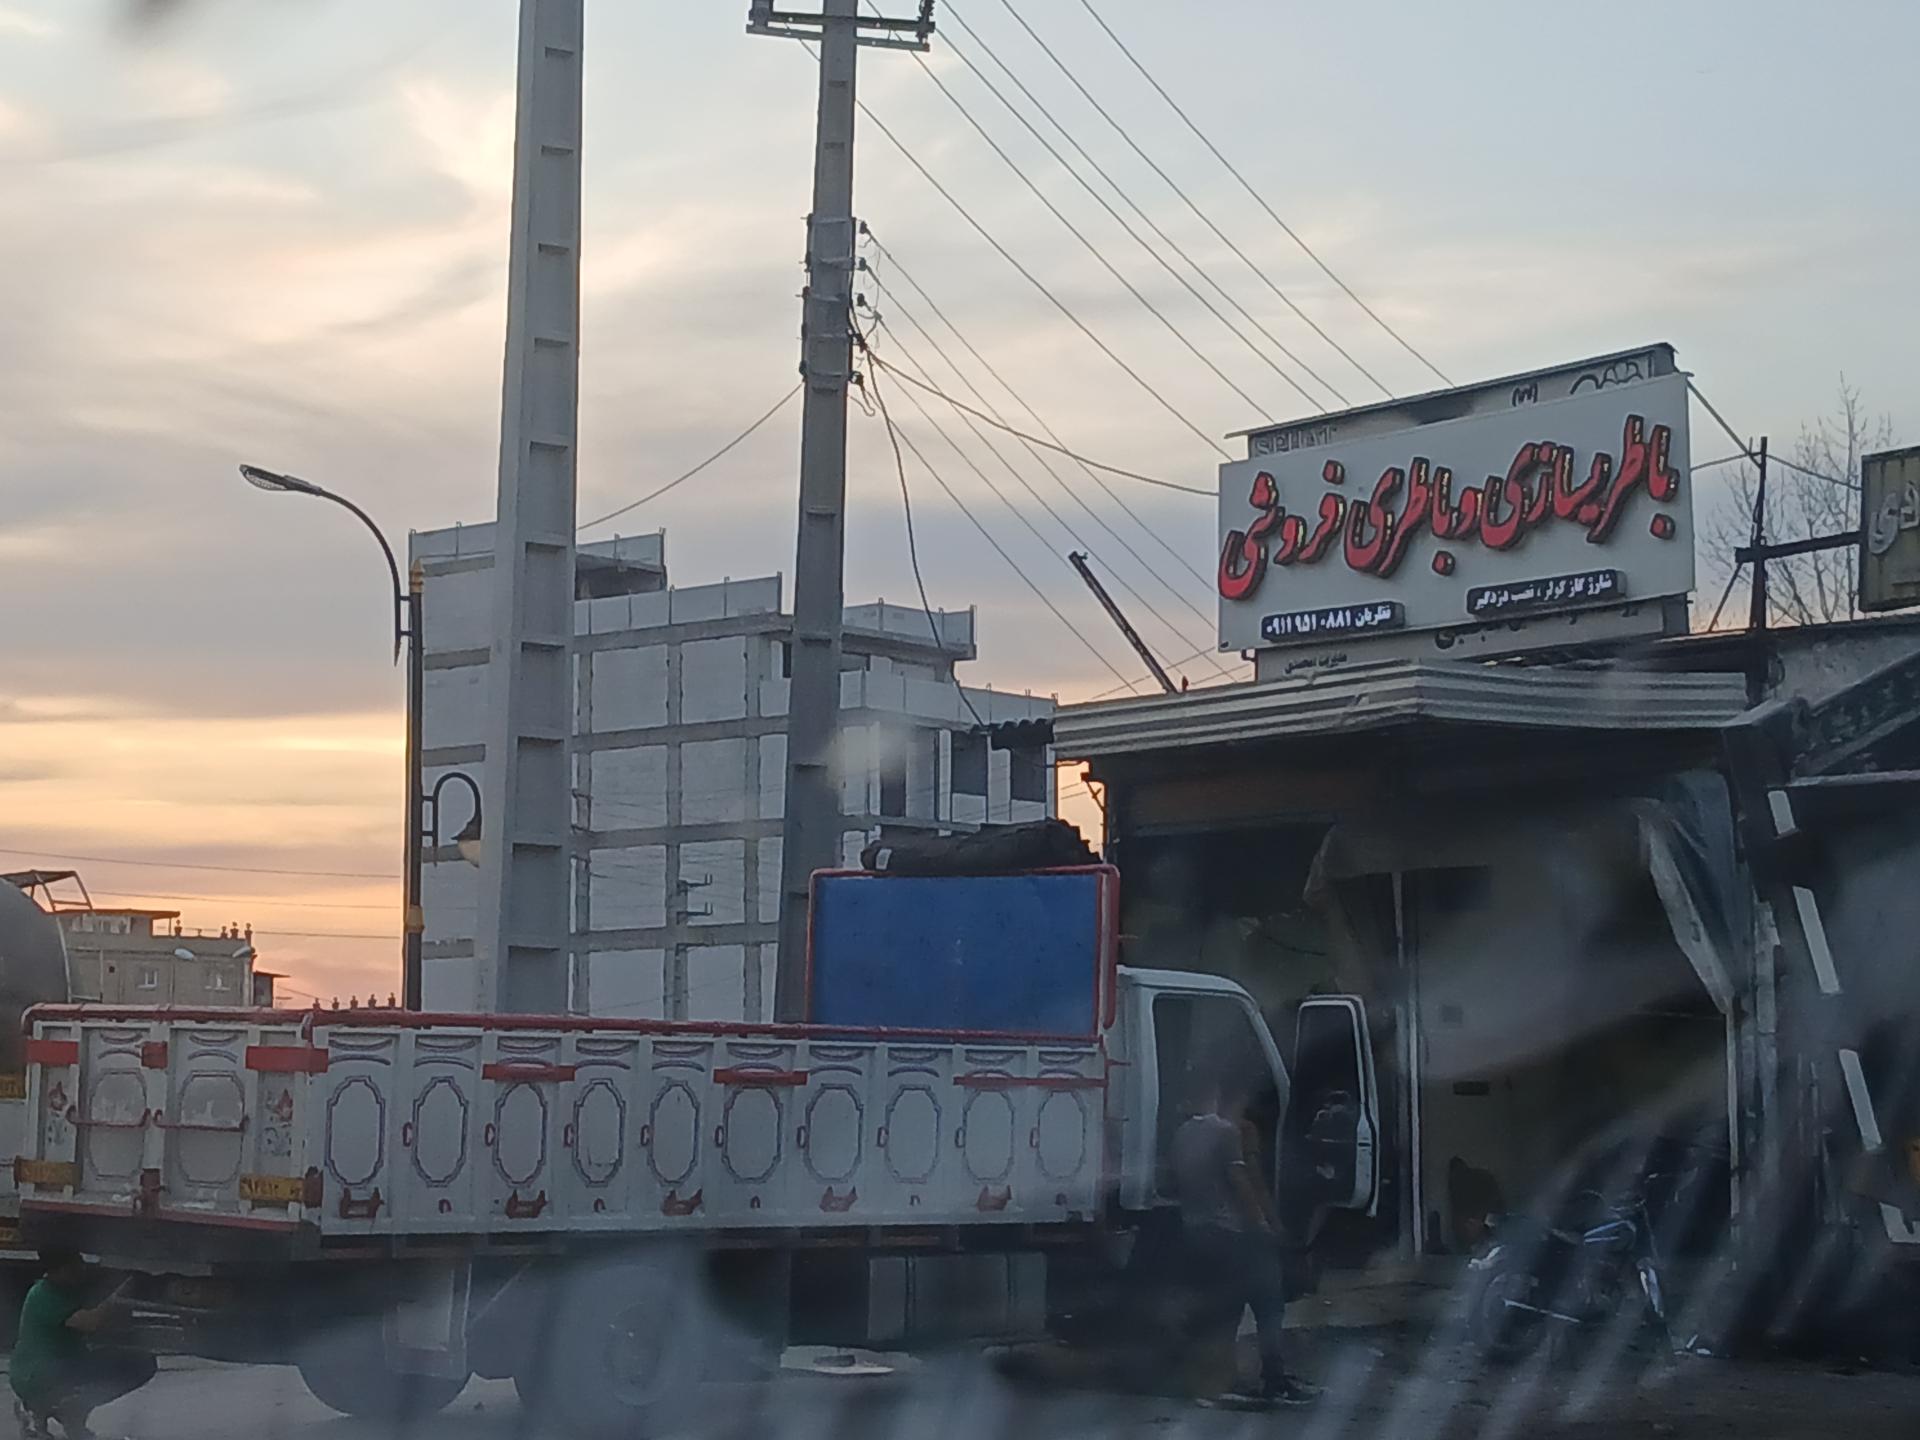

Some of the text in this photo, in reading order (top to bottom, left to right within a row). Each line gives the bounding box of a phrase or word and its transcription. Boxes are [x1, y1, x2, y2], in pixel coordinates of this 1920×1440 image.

[1344, 456, 1456, 579] باطری
[1453, 487, 1484, 540] و
[1218, 459, 1347, 600] فروشی
[1511, 584, 1535, 602] نصب
[1567, 577, 1586, 599] گاز
[1587, 573, 1613, 596] شارژ
[1474, 589, 1509, 611] دزدگیر
